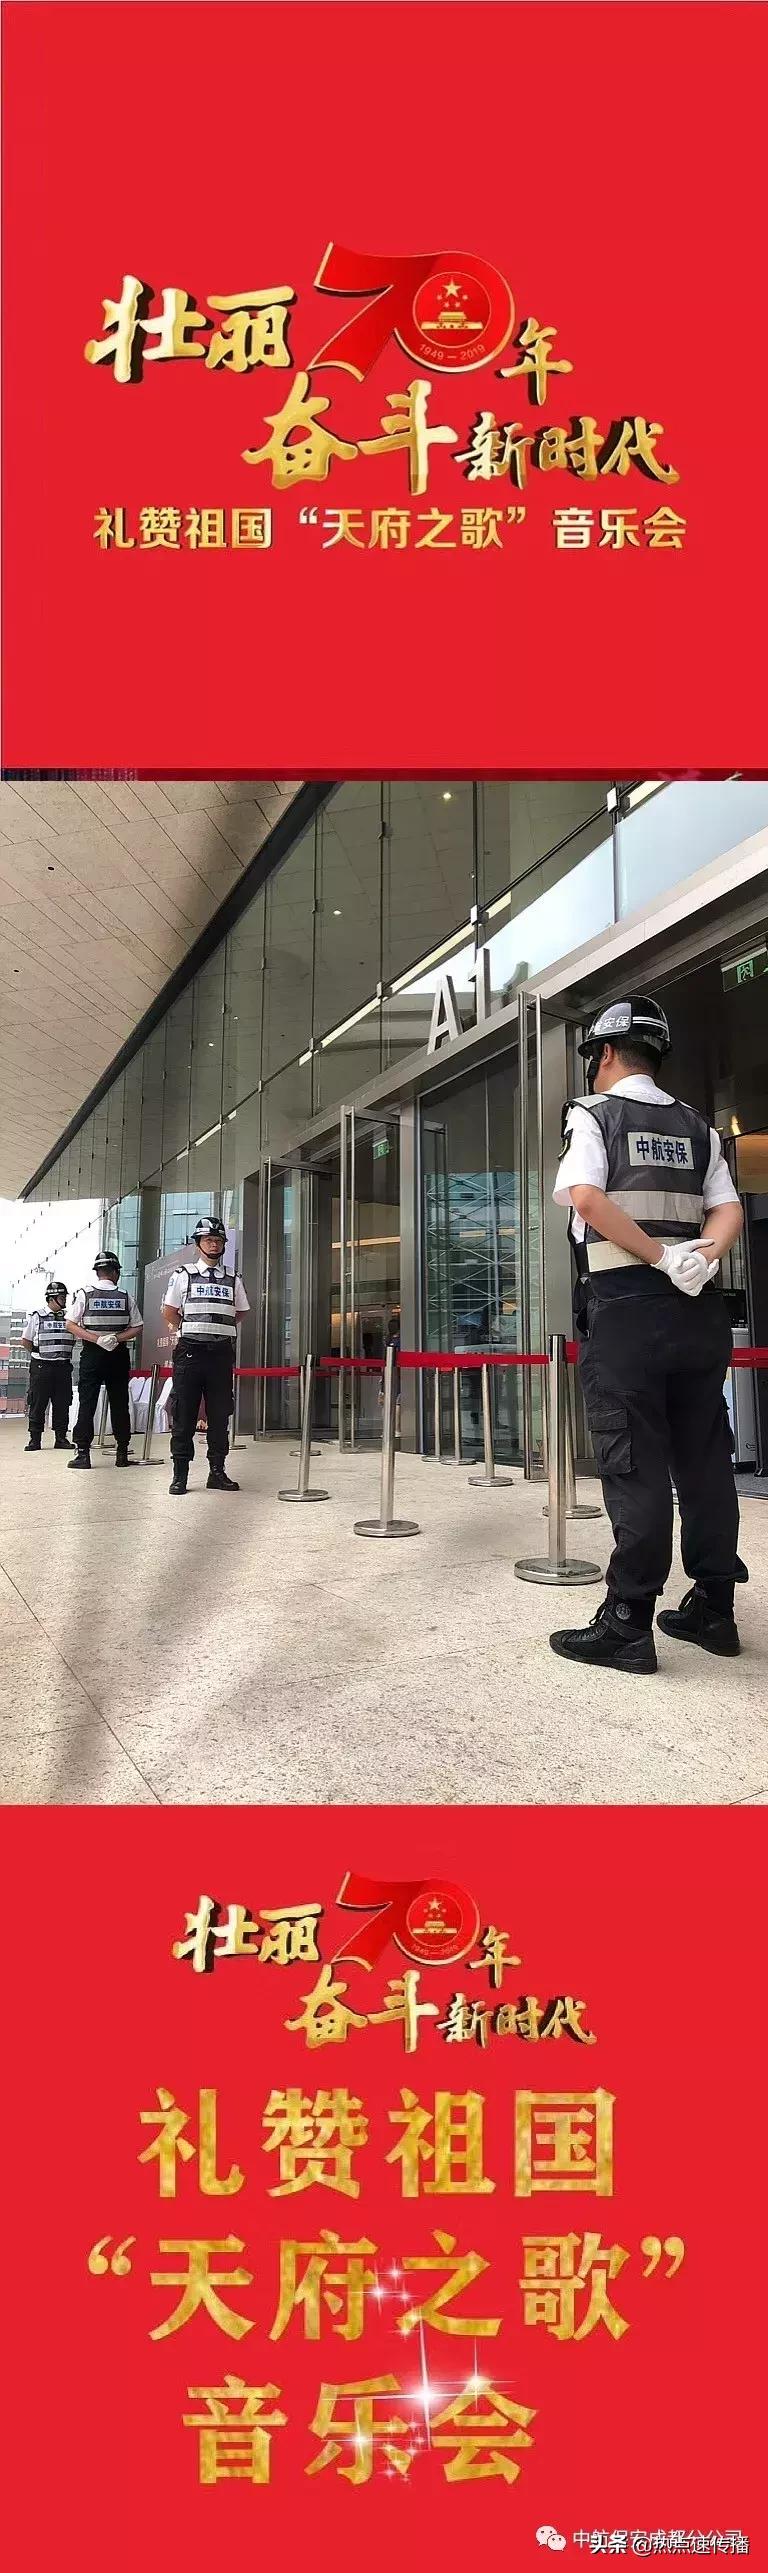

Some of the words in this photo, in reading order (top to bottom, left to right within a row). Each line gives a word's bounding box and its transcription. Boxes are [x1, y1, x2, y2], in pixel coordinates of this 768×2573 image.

[240, 371, 682, 496] 奋斗新时代
[93, 506, 273, 549] 礼赞祖国
[552, 506, 687, 550] 音乐会
[427, 948, 492, 1055] A1
[636, 1135, 688, 1164] 中航安保
[196, 1285, 230, 1298] 中航安保
[283, 1965, 598, 2053] 奋斗新时代
[137, 2087, 617, 2200] 礼赞祖国
[87, 2229, 686, 2342] “天府之歌”
[182, 2373, 539, 2486] 音乐会
